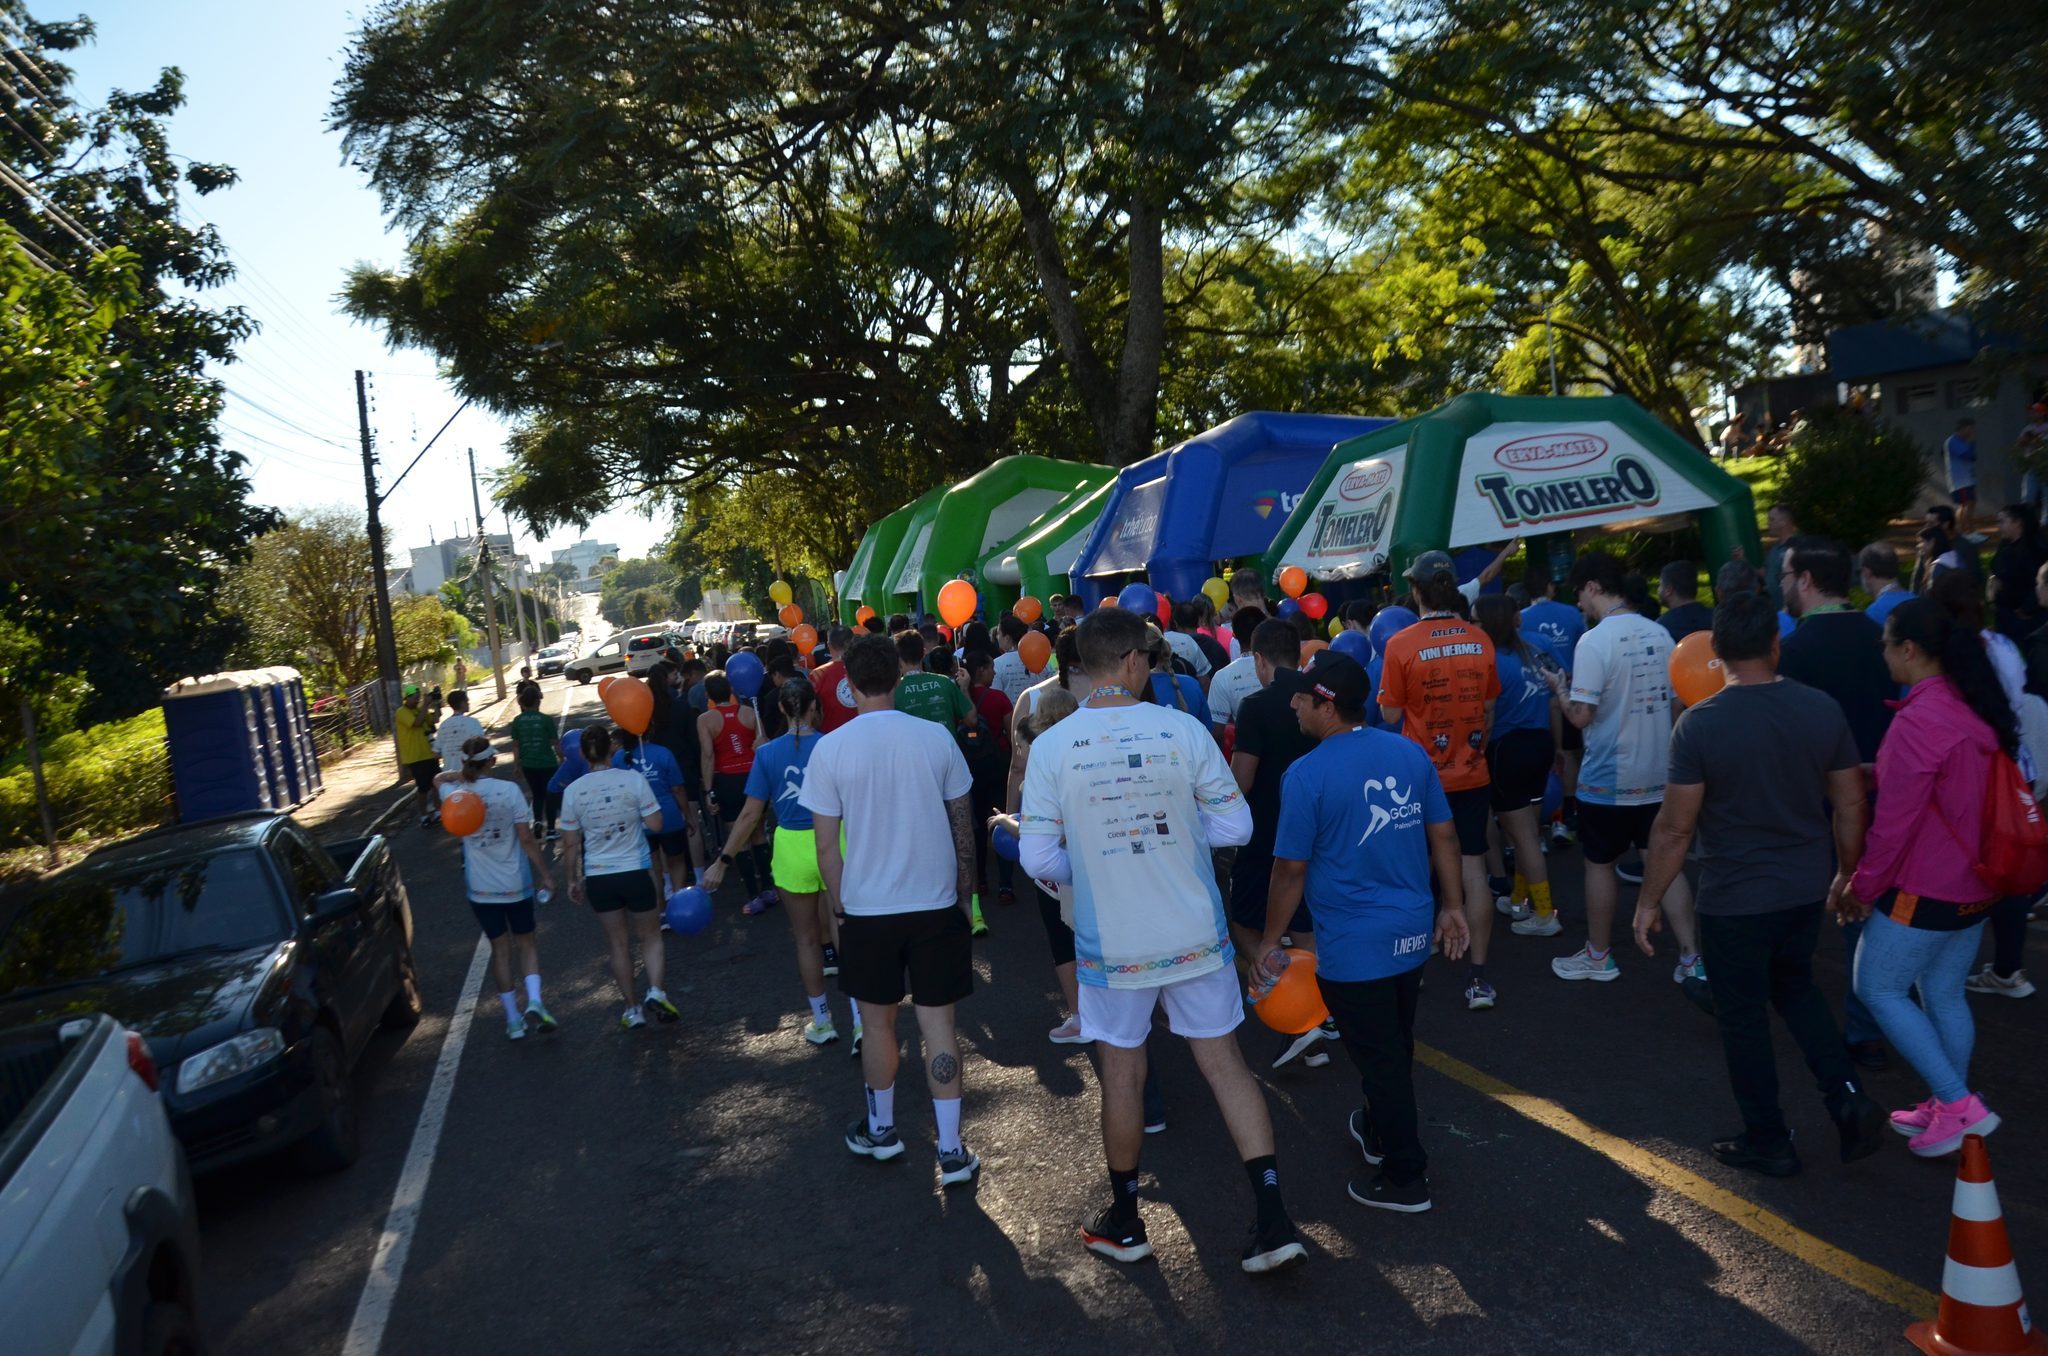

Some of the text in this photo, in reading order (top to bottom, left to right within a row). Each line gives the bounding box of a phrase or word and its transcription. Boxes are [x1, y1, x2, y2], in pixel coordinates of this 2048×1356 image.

[1477, 456, 1659, 523] TOMELERO
[1311, 489, 1393, 551] TOMELERO
[1431, 627, 1467, 638] ATLETA
[1418, 642, 1483, 661] VINI HERMES
[904, 680, 942, 695] ATLETA
[1390, 802, 1422, 820] GCOR
